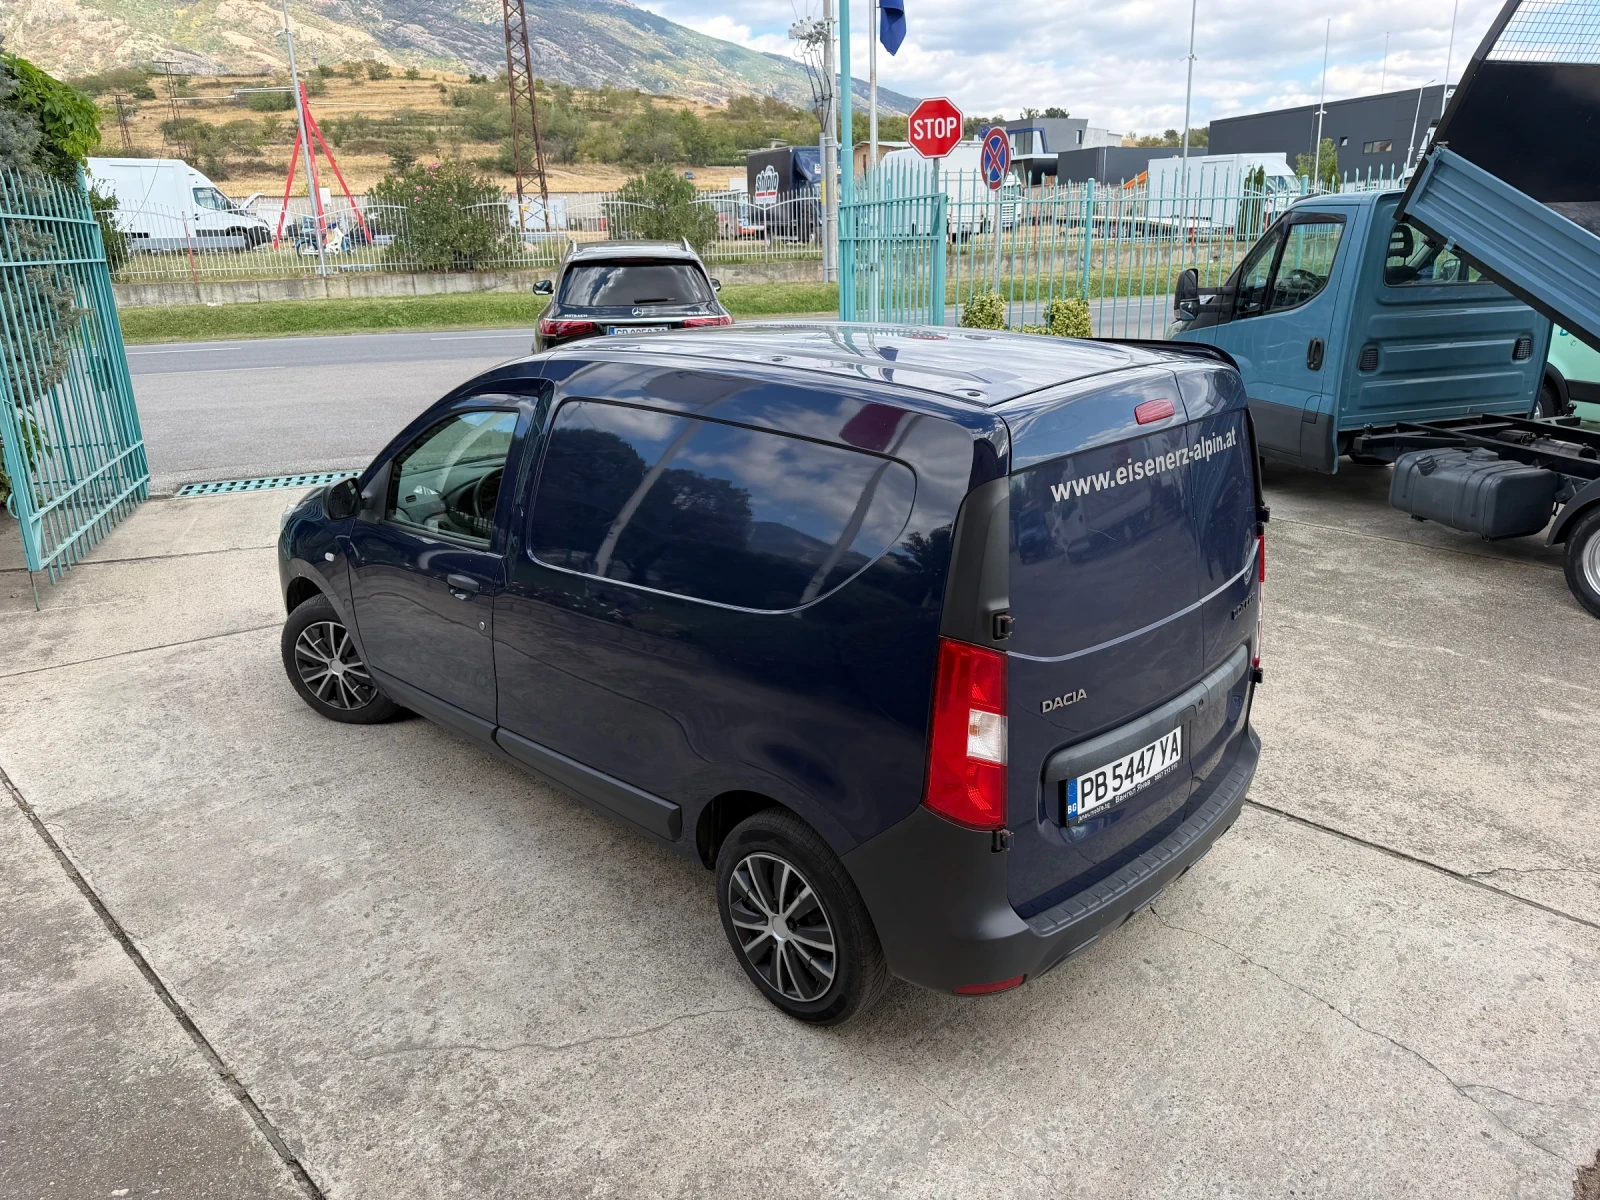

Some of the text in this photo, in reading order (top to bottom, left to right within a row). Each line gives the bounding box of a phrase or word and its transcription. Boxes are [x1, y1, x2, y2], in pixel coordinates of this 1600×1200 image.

[913, 116, 957, 140] STOP
[1051, 426, 1236, 502] www.eisenerz-alpin.at
[1042, 688, 1087, 713] DACIA
[1081, 732, 1179, 809] PB 5447 YA
[1067, 803, 1077, 814] BG
